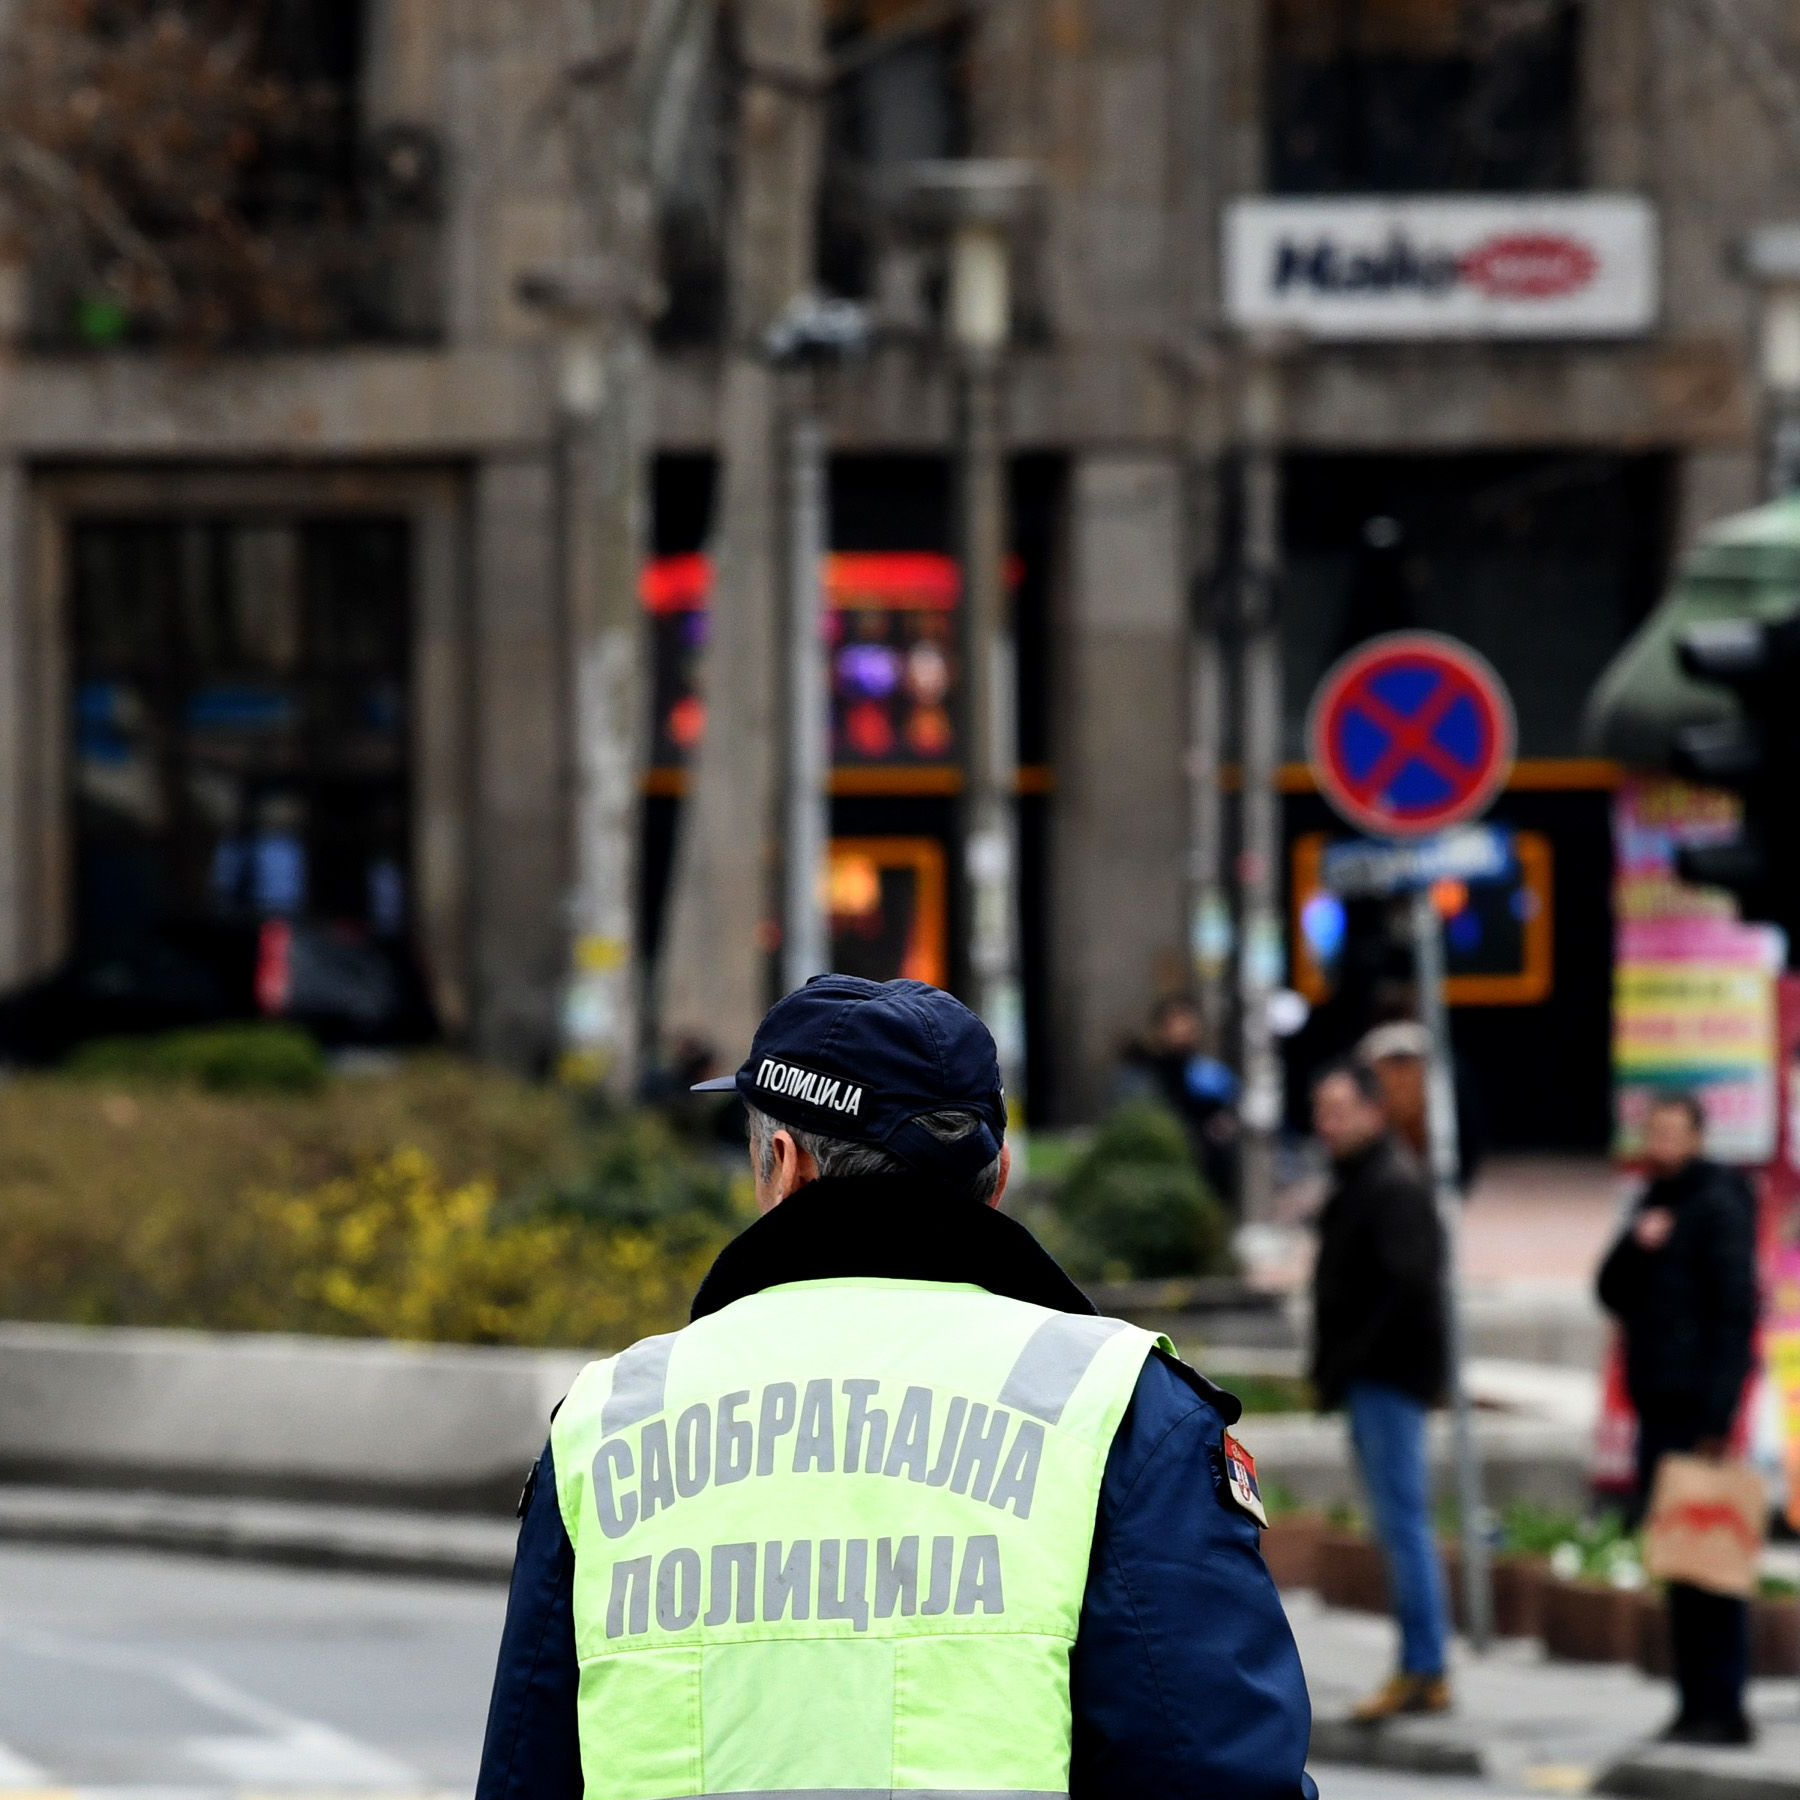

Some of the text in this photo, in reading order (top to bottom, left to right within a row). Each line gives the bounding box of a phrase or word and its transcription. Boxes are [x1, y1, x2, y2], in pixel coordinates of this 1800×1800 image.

[755, 1058, 863, 1116] ПОЛИЦИЈА
[591, 1377, 1046, 1540] САОБРАЋАЈНА
[605, 1534, 1005, 1639] ПОЛИЦИЈА
